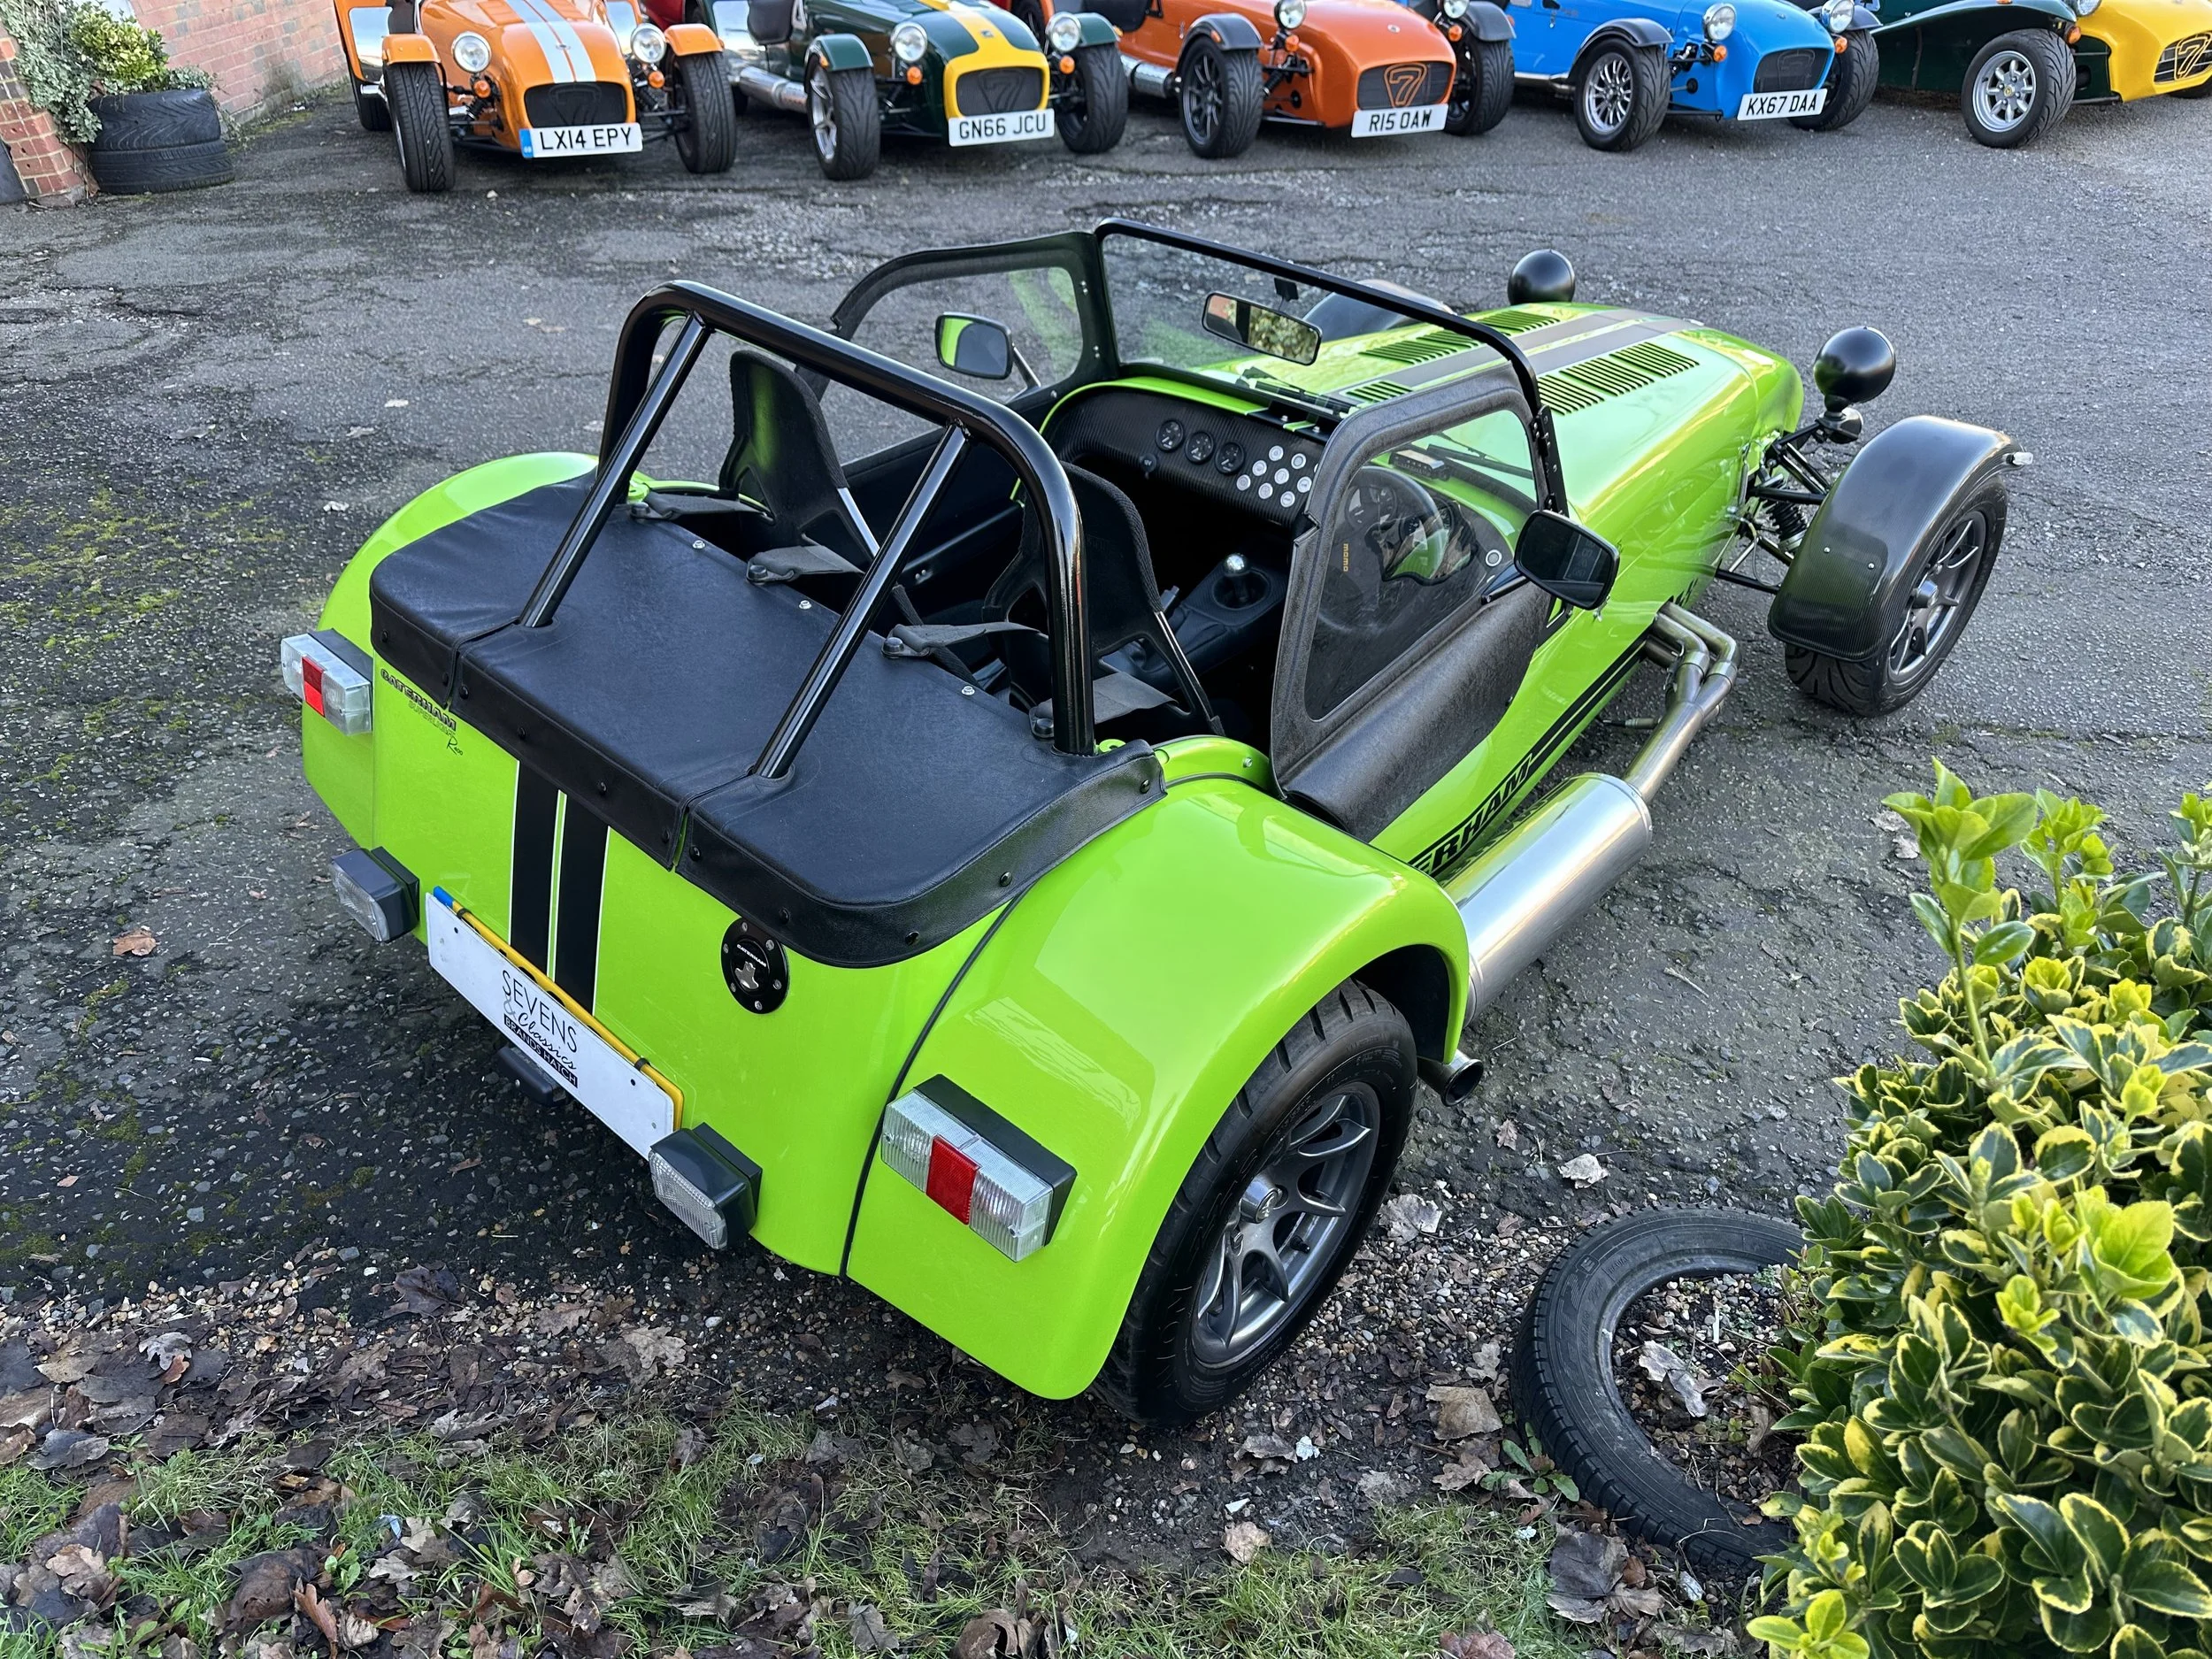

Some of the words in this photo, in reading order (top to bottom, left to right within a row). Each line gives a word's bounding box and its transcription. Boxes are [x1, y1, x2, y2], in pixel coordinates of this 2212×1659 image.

[1388, 66, 1423, 106] 7
[1746, 96, 1787, 116] KX67
[1788, 93, 1817, 113] DAA
[540, 128, 587, 150] LX14
[593, 127, 631, 147] EPY
[959, 118, 1006, 139] GN66
[1013, 112, 1046, 134] JCU
[1369, 112, 1396, 132] R15
[380, 668, 457, 732] CATERHAM
[736, 943, 767, 968] CATERHAM
[502, 970, 577, 1053] SEVENS
[505, 1017, 541, 1055] BRANDS
[543, 1050, 577, 1087] HATCH
[518, 1012, 577, 1070] Classics
